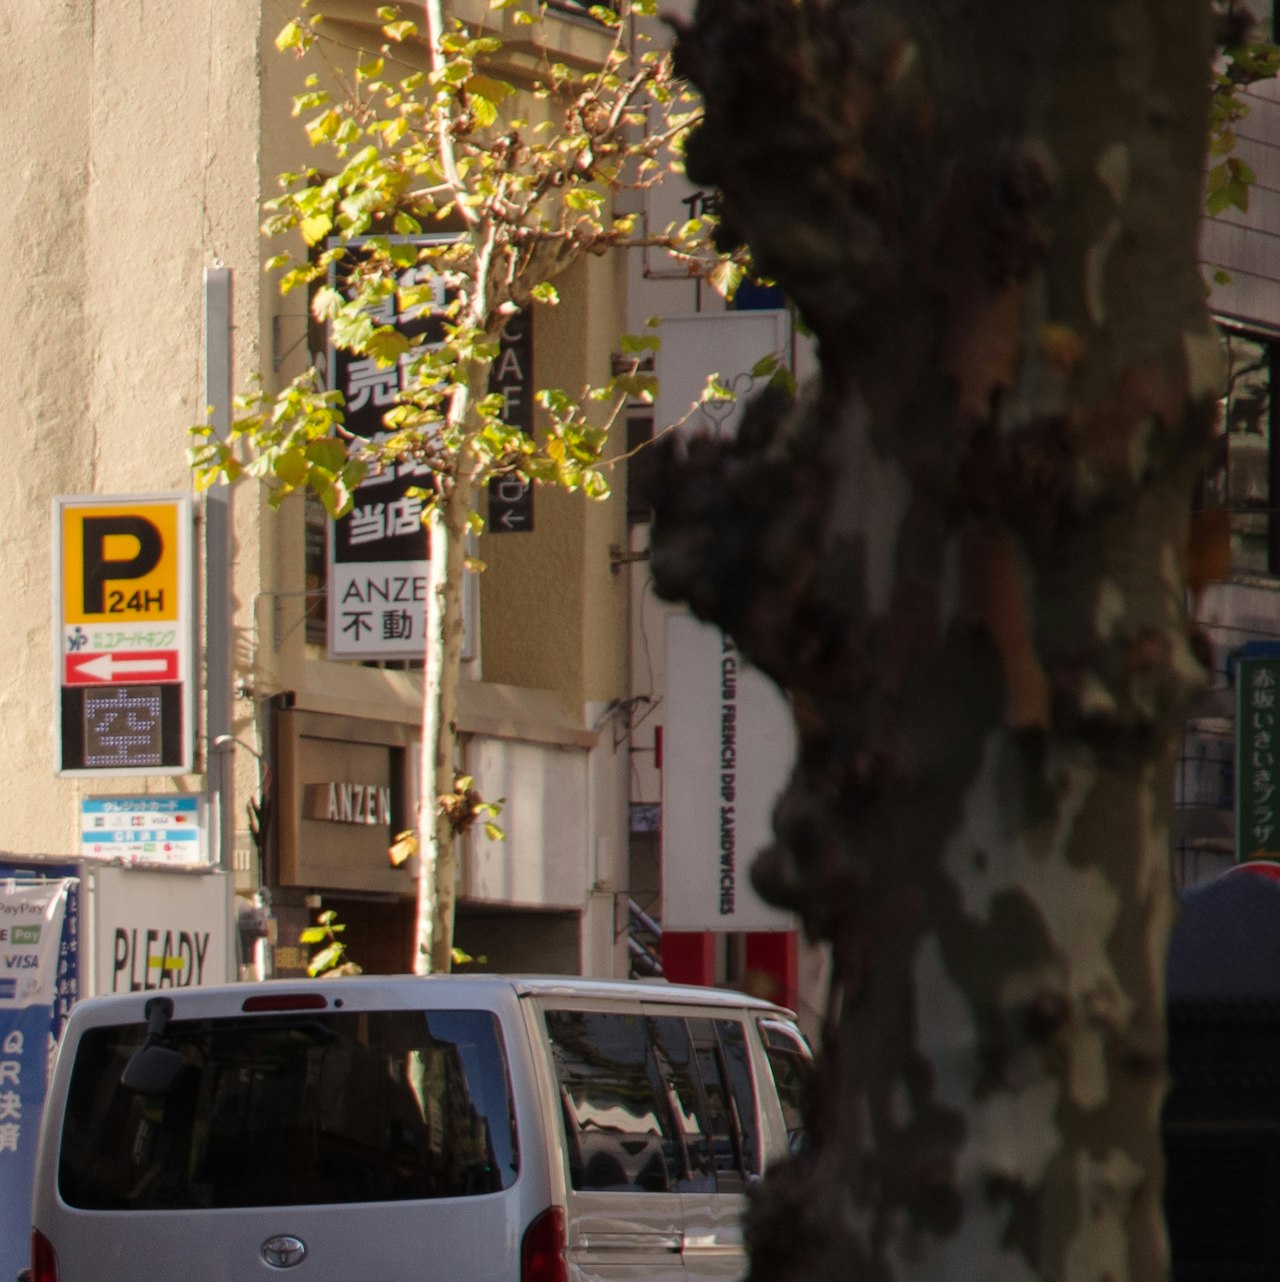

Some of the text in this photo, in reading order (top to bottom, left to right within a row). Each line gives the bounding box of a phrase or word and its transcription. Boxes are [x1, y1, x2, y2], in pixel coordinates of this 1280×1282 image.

[498, 316, 524, 430] CAF
[83, 515, 164, 614] P
[109, 589, 165, 613] 24H
[342, 609, 428, 641] 不動
[721, 656, 737, 700] CLUB
[86, 688, 162, 765] 空
[721, 704, 737, 770] FRENCH
[328, 782, 391, 825] ANZEN
[719, 806, 736, 915] SANDWICHES
[5, 954, 40, 969] VISA
[15, 929, 40, 942] Pay
[113, 927, 211, 993] PLEADY
